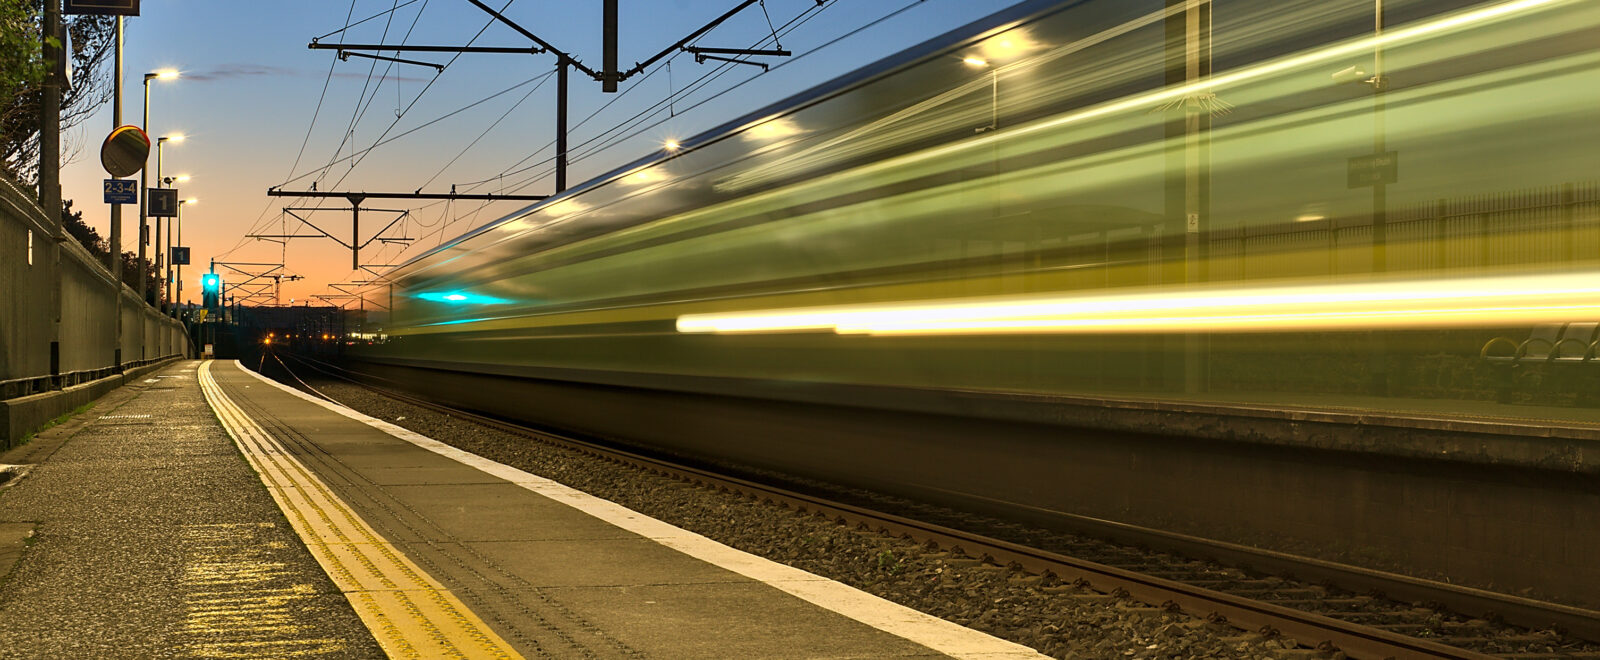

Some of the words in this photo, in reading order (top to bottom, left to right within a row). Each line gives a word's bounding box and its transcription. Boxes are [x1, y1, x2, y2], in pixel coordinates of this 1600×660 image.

[105, 182, 136, 194] 2-3-4
[159, 195, 167, 210] 1
[178, 251, 184, 261] 1
